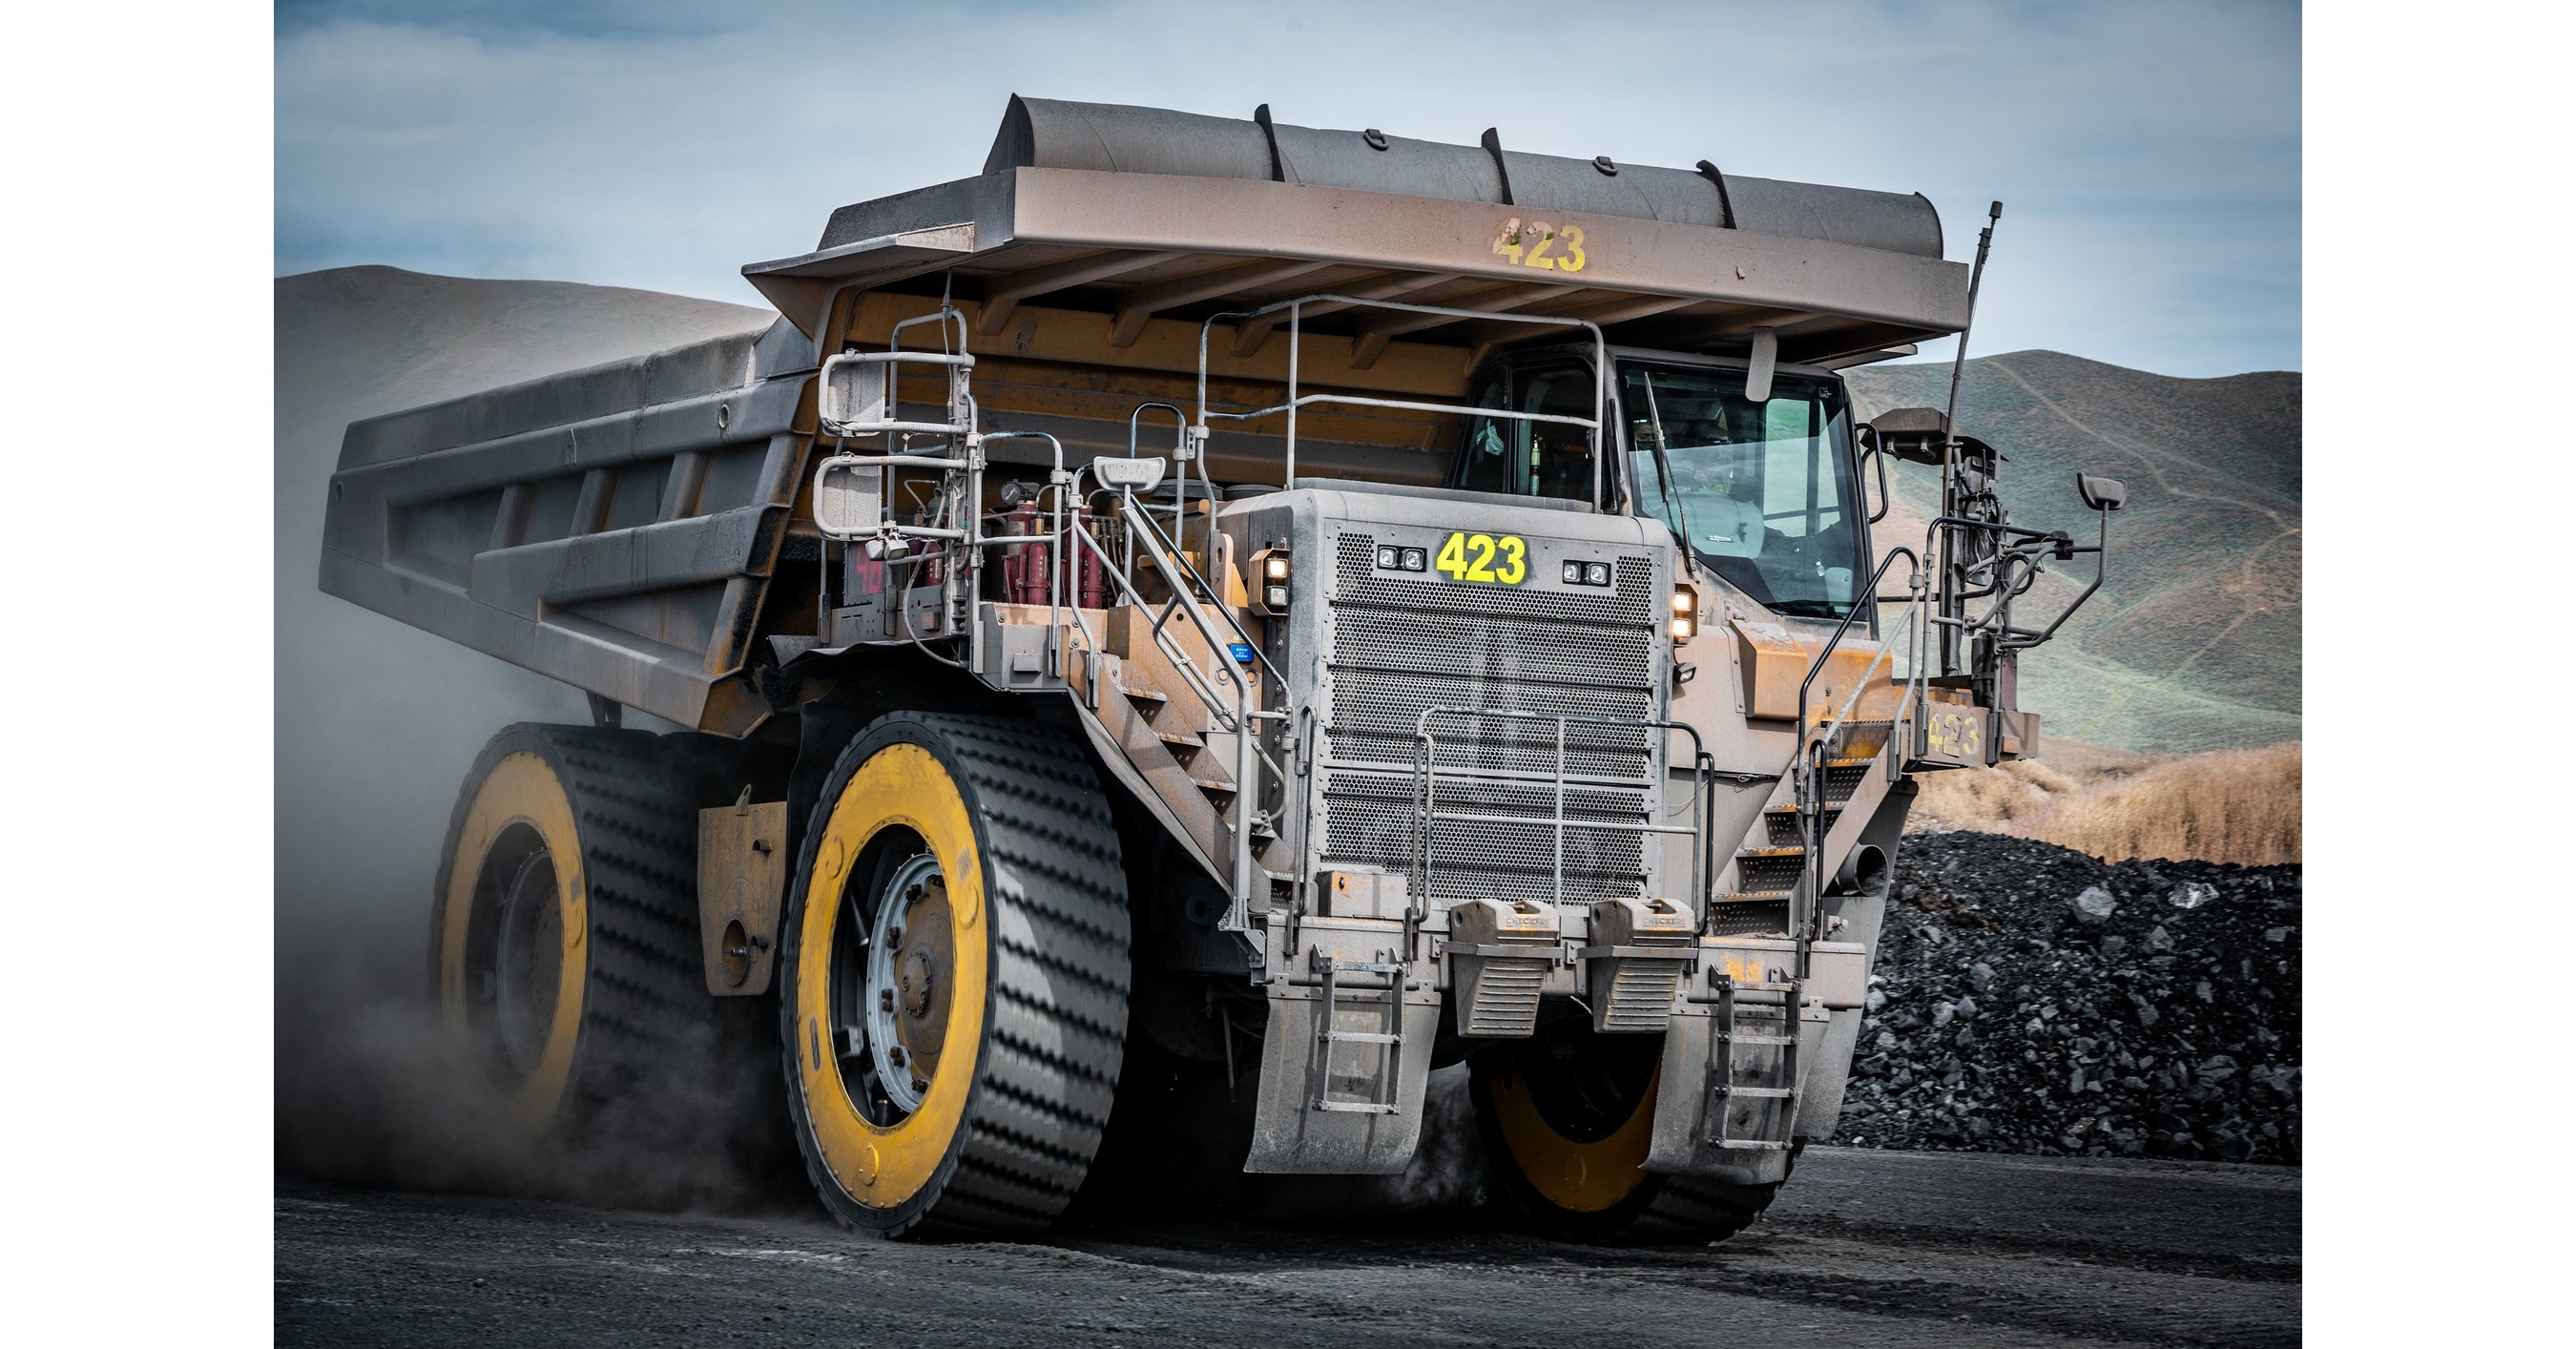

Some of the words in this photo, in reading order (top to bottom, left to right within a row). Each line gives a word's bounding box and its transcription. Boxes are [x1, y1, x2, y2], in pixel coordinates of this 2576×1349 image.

[1492, 218, 1586, 272] 423
[1436, 531, 1526, 585] 423
[1928, 713, 1980, 758] 423
[1505, 917, 1550, 925] CHECKERS
[1641, 917, 1686, 925] CHECKERS
